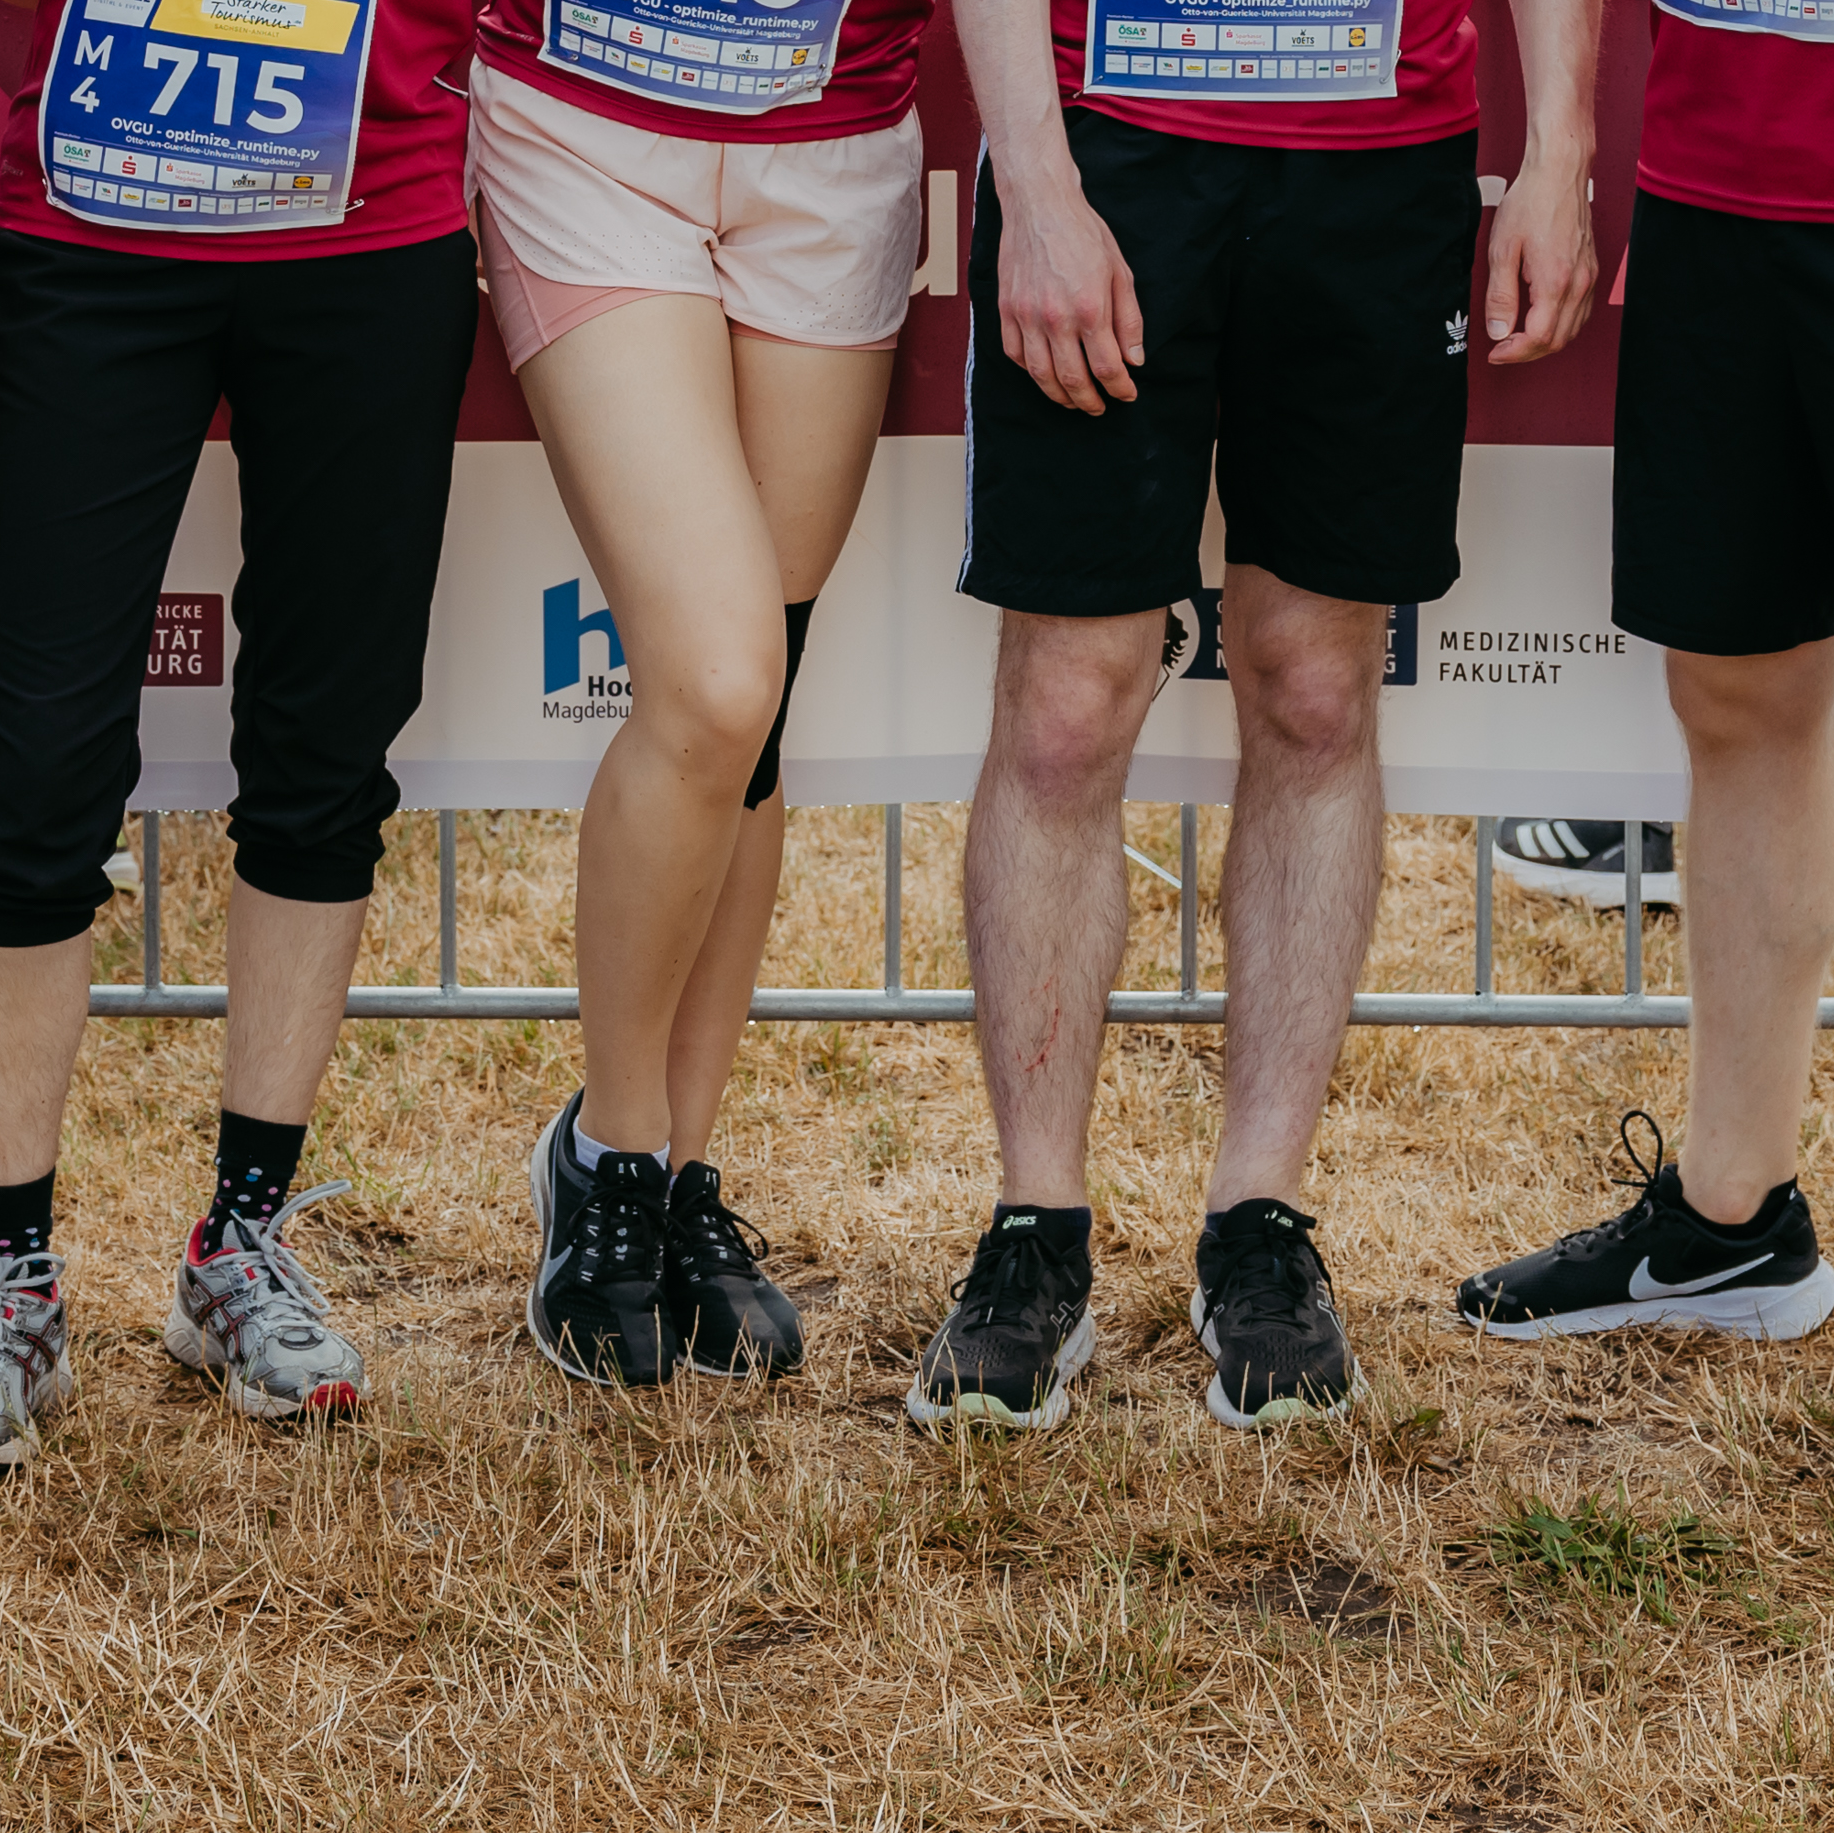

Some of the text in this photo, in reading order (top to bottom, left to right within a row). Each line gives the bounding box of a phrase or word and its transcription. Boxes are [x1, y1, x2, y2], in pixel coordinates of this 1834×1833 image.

[209, 1, 297, 30] Tourismus
[633, 6, 801, 40] Otto-von-Guericke-Universität Magdeburg
[672, 3, 819, 32] optimize_runtime.py
[1181, 7, 1354, 18] Otto-von-Guericke-Universität Magdeburg
[213, 23, 280, 38] SACHSEN-ANHALT
[73, 30, 115, 71] M
[69, 75, 100, 113] 4
[143, 41, 306, 134] 715
[110, 117, 154, 136] OVGU
[165, 127, 320, 161] optimize_runtime.py
[125, 134, 301, 169] Otto-von-Guericke-Universität Magdeburg
[1439, 630, 1627, 654] MEDIZINISCHE
[1439, 658, 1563, 684] FAKULTÄT
